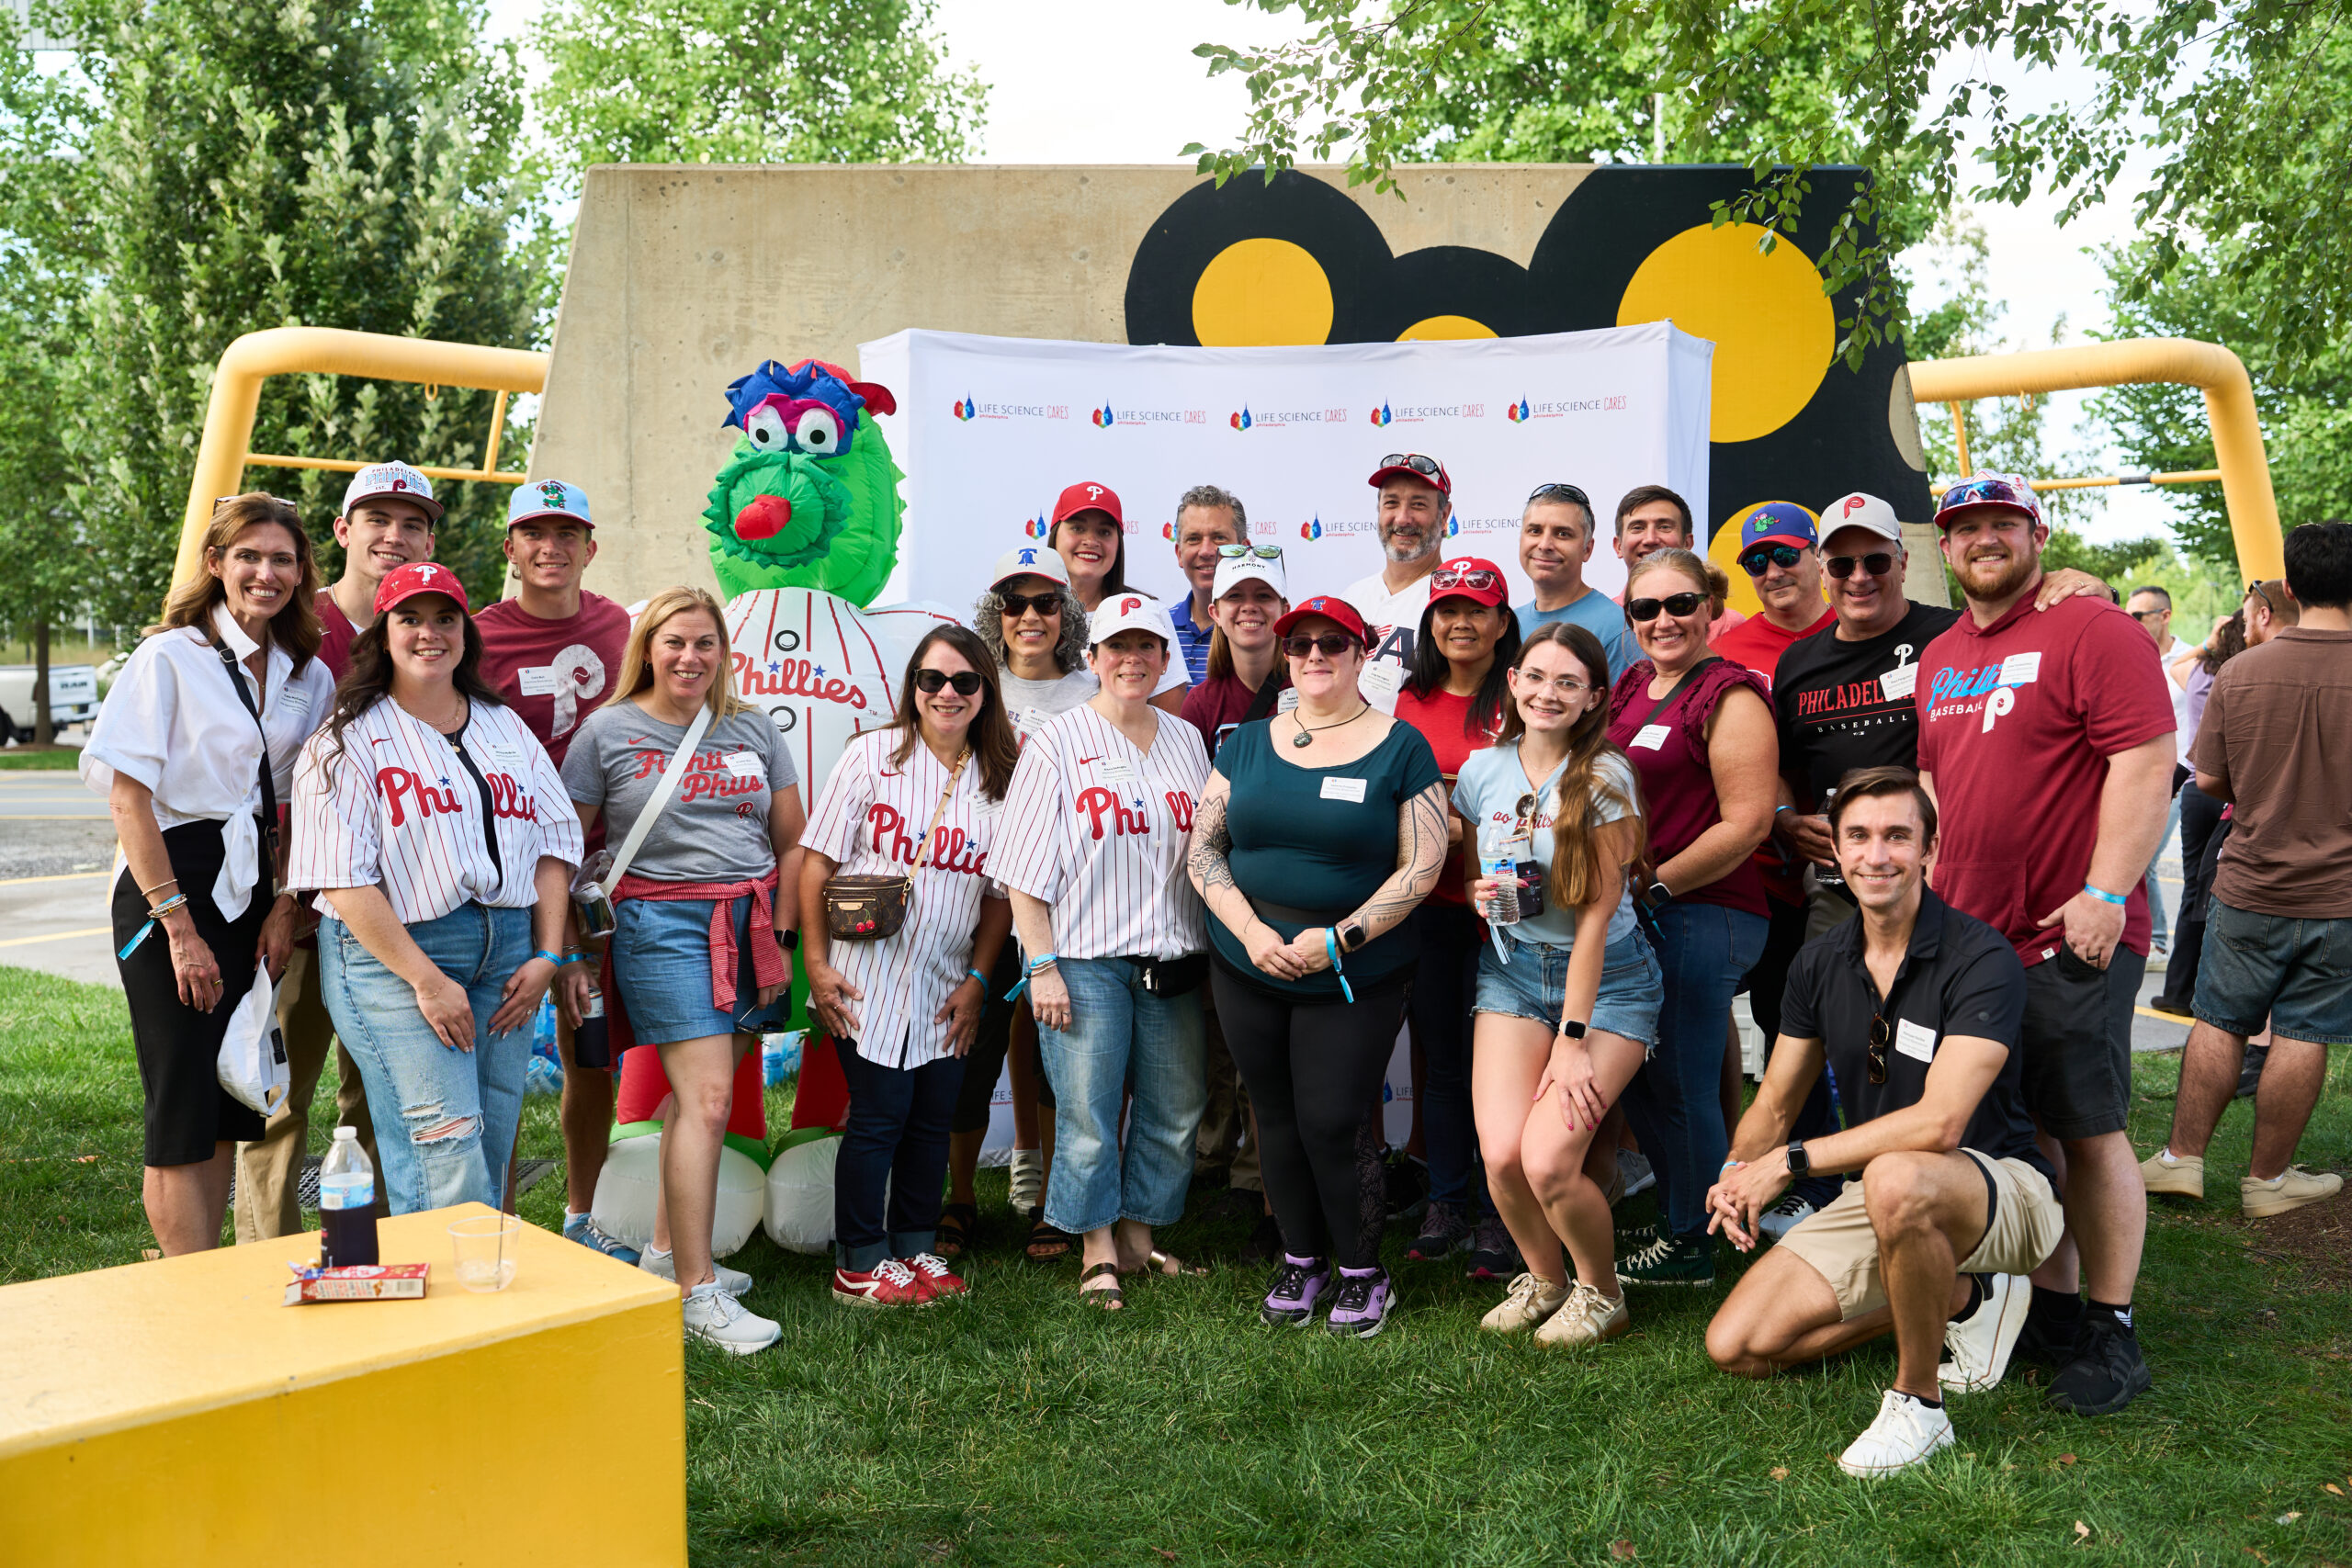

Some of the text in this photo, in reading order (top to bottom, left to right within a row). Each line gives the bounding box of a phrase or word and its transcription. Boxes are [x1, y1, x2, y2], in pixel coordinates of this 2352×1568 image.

[978, 404, 1069, 419] LIFE SCIENCE CARES
[1395, 404, 1484, 418] LIFE SCIENCE CARES
[1533, 395, 1626, 413] LIFE SCIENCE CARES
[1116, 410, 1206, 423] LIFE SCIENCE CARES
[1255, 408, 1347, 423] LIFE SCIENCE CARES
[1086, 485, 1103, 501] P
[1844, 496, 1865, 519] P
[1123, 520, 1139, 535] ARES
[1255, 521, 1277, 536] CARES
[1326, 522, 1377, 532] LIFE SCIEN
[1463, 518, 1522, 529] LIFE SCIENC
[414, 565, 437, 582] P
[1232, 562, 1265, 570] HARMONY
[1453, 560, 1472, 578] P
[1121, 597, 1142, 617] P
[1894, 643, 1914, 669] P
[551, 644, 605, 739] P
[1926, 663, 2027, 713] Philli
[1797, 679, 1916, 716] PHILADEL
[1982, 686, 2015, 734] P
[1817, 714, 1908, 733] BASEBALL
[633, 744, 744, 786] Fihti'
[376, 766, 537, 828] Phillie
[1076, 786, 1200, 840] Phill
[867, 803, 989, 877] Phllie
[991, 1090, 1005, 1100] IFE
